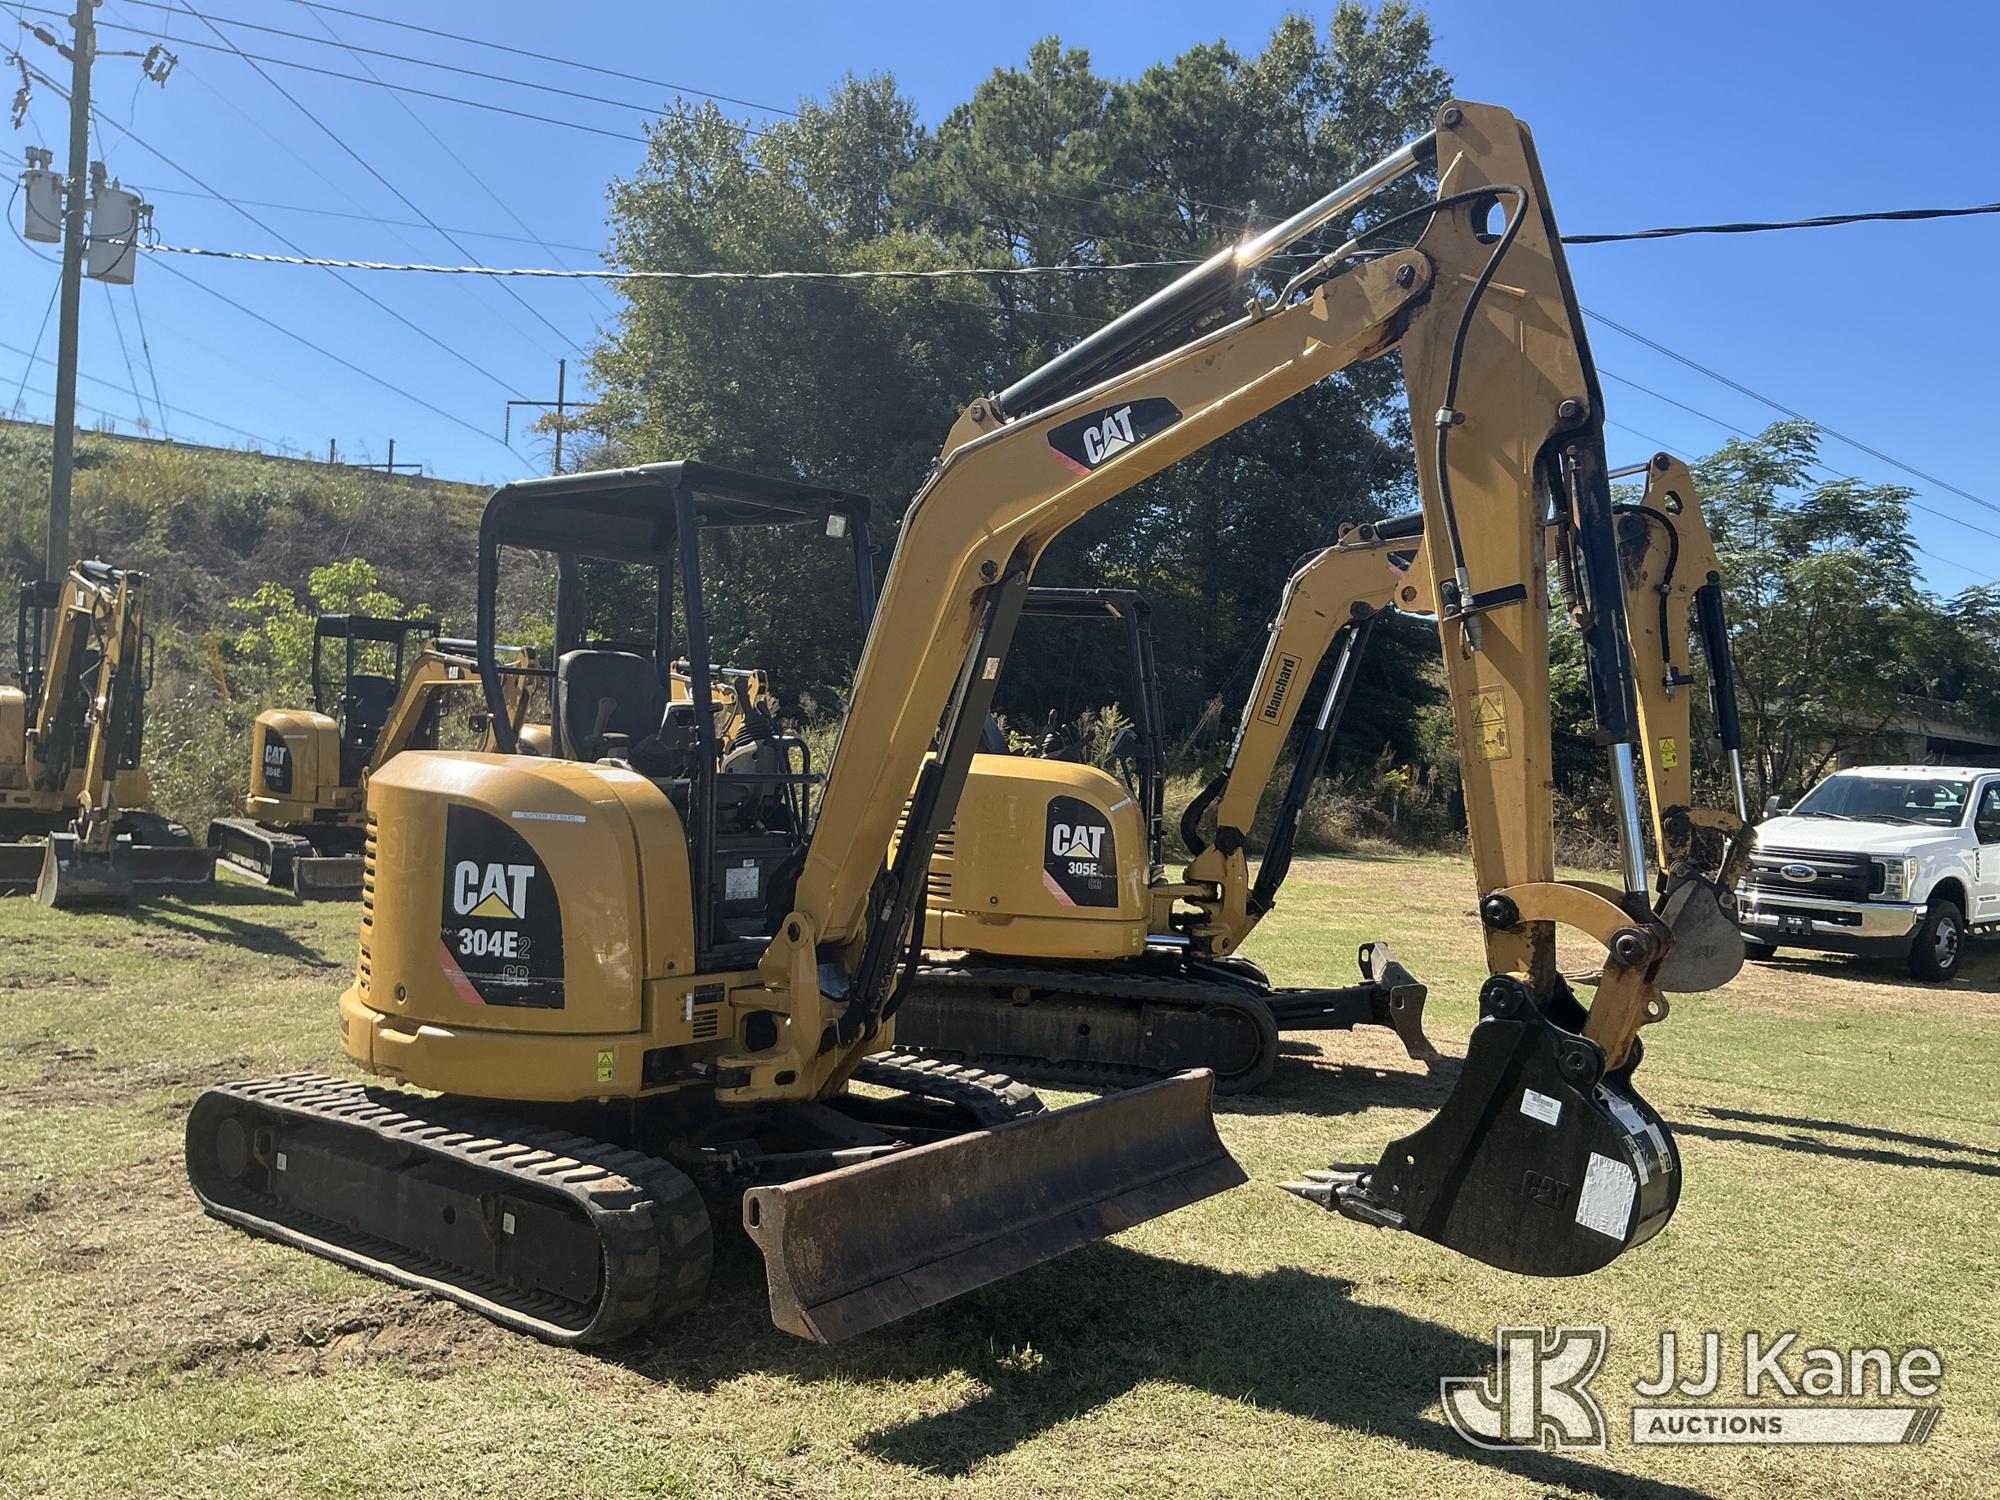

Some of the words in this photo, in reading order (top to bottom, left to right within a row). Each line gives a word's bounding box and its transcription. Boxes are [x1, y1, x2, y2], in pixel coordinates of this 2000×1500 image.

[1083, 405, 1135, 465] CAT
[1264, 658, 1296, 719] Blanchard
[265, 744, 287, 765] CAT
[1052, 823, 1105, 858] CAT
[453, 860, 535, 919] CAT
[502, 965, 529, 987] CR
